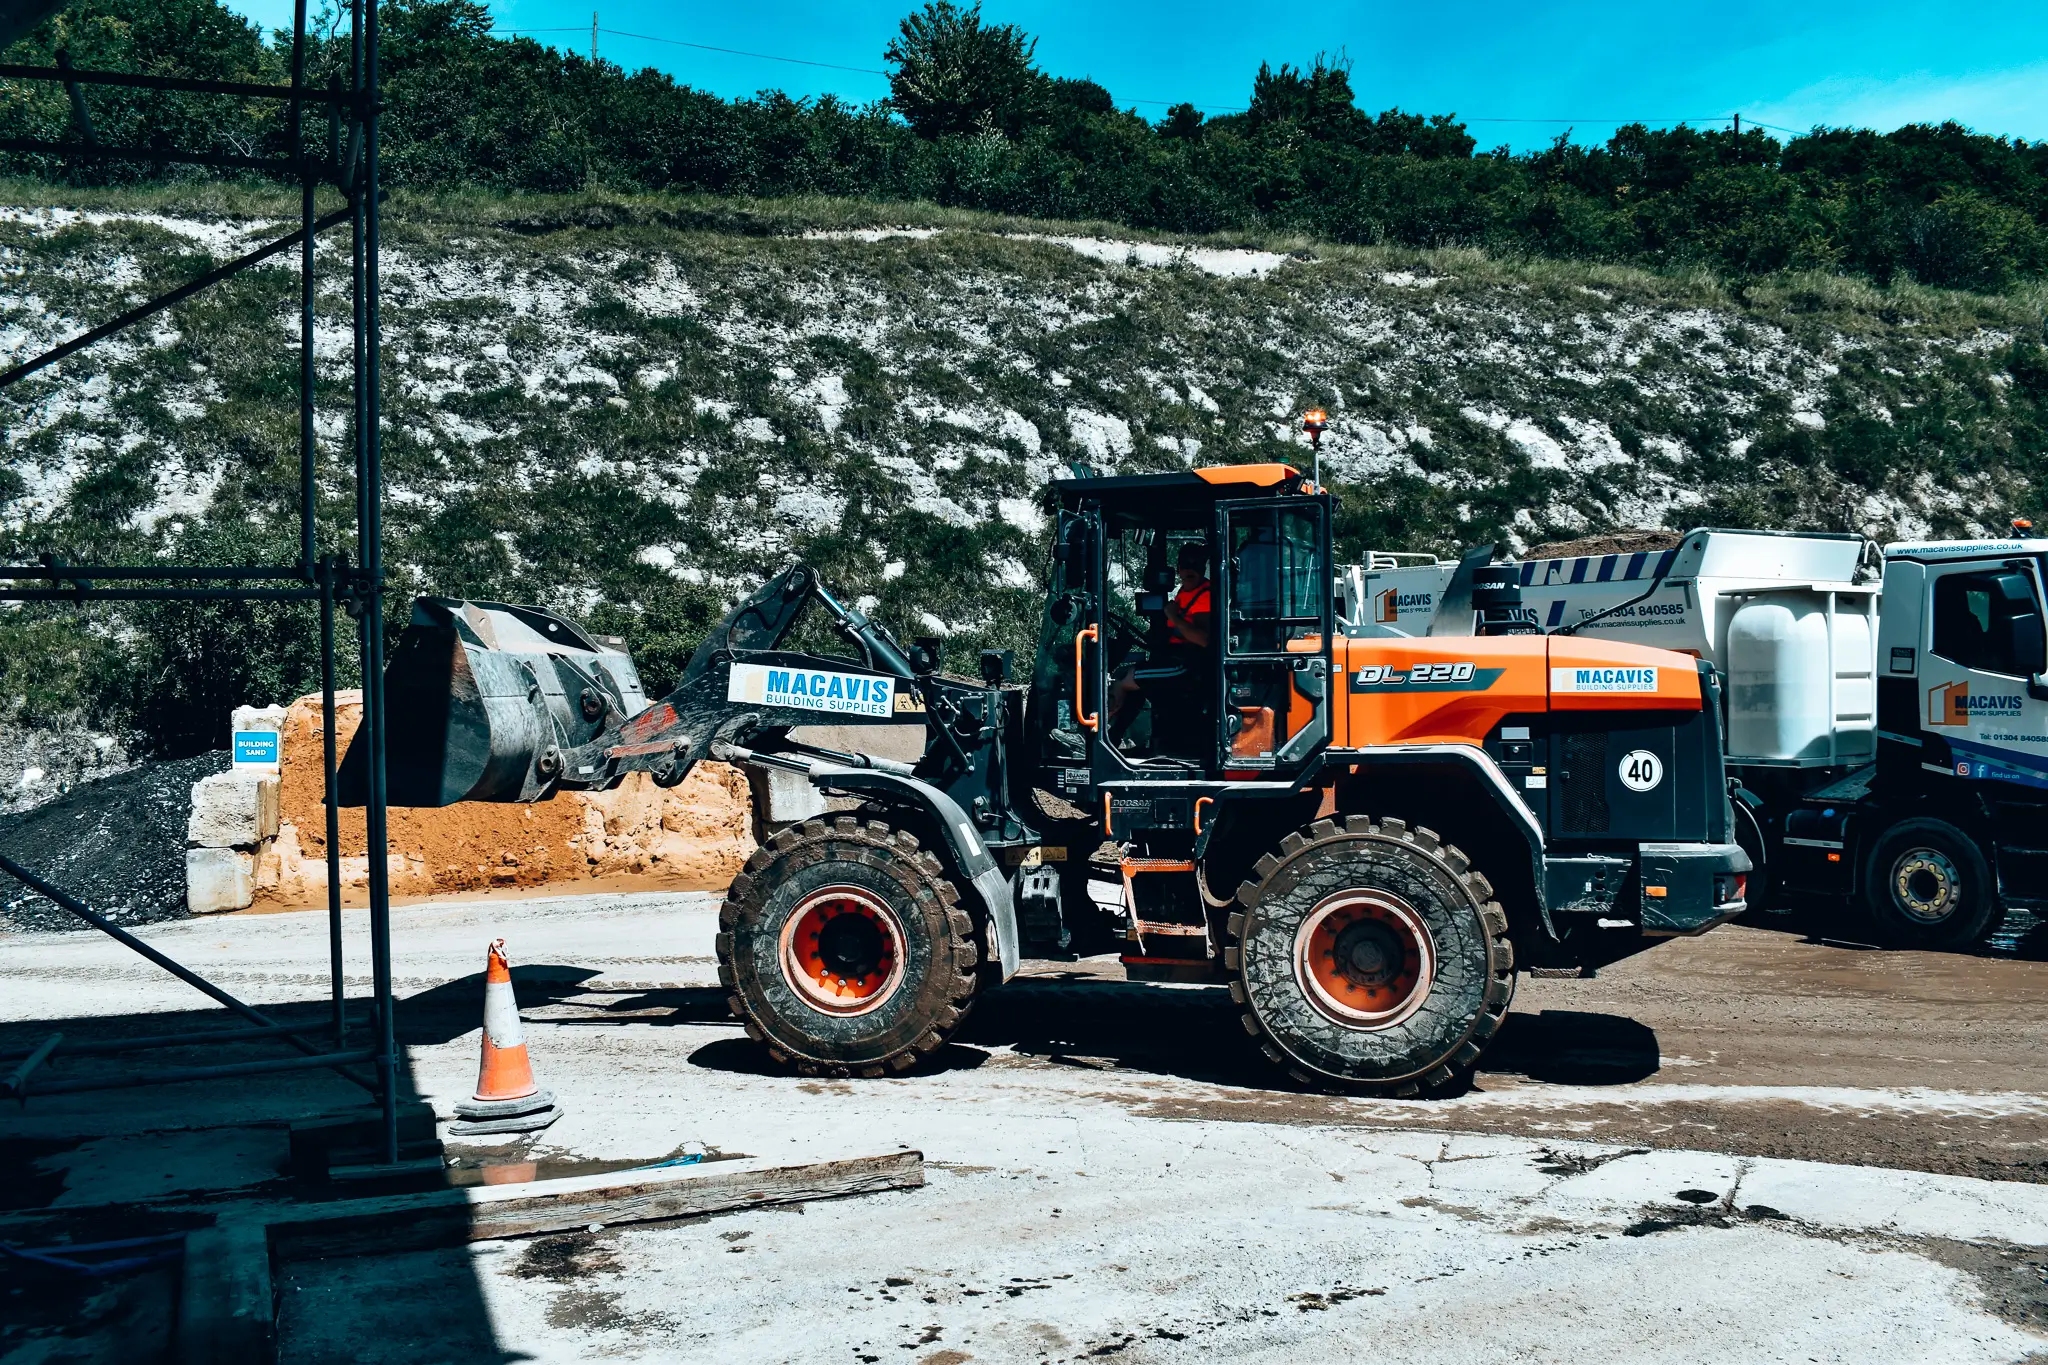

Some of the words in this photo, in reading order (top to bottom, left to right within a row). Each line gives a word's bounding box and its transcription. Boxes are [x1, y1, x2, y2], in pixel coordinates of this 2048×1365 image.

[1896, 543, 2023, 555] www.macavissupplies.co.uk
[1389, 594, 1432, 607] MACAVIS
[1638, 603, 1685, 616] 840585
[1356, 664, 1406, 686] DL
[1408, 662, 1477, 684] 220
[1576, 669, 1654, 684] MACAVIS
[767, 670, 889, 703] MACAVIS
[766, 694, 824, 708] BUILDING
[829, 701, 886, 715] SUPPLIES
[1955, 695, 2023, 709] MACAVIS
[1993, 733, 2018, 741] 01304
[1628, 759, 1653, 783] 40
